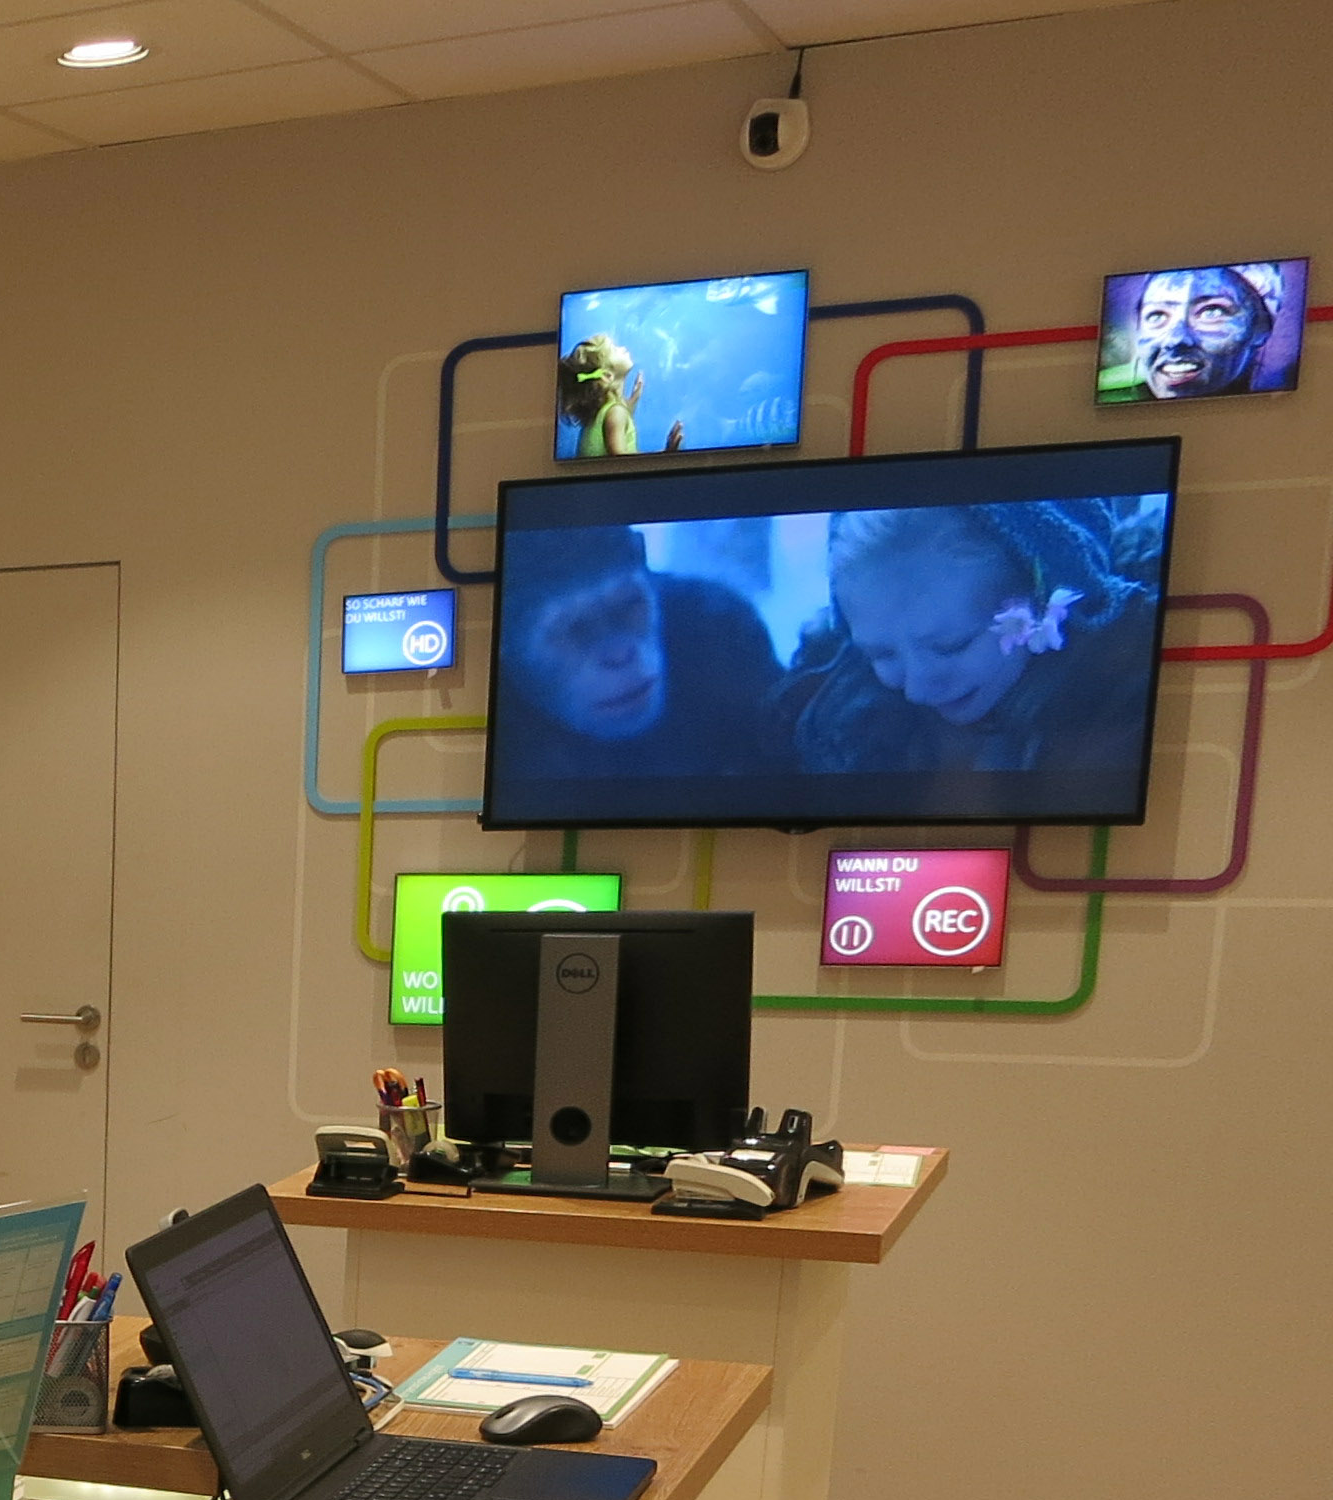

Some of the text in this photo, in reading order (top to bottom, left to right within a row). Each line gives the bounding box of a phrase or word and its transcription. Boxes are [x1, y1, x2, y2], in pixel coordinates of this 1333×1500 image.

[345, 594, 428, 611] SO SCHARF WIE
[345, 609, 406, 624] DU WILLST!
[409, 633, 440, 654] HD
[836, 857, 919, 872] WANN DU
[835, 877, 901, 893] WILLST!
[924, 909, 978, 933] REC
[402, 971, 438, 990] WO
[561, 968, 595, 978] DELL
